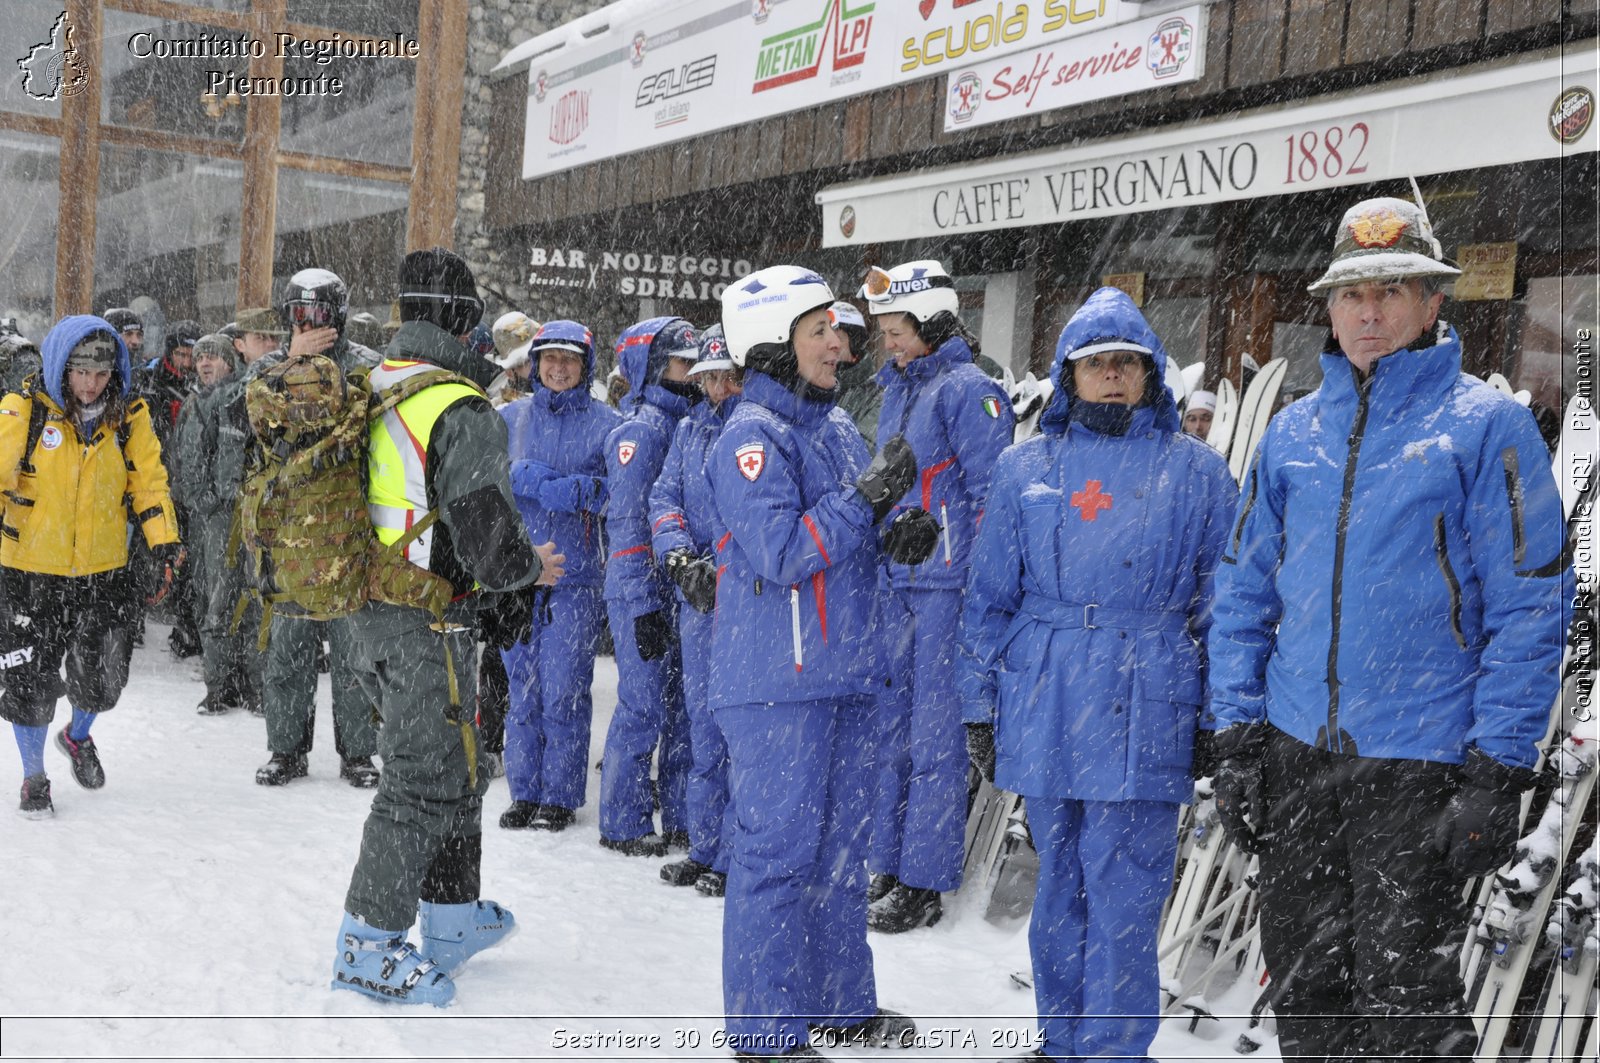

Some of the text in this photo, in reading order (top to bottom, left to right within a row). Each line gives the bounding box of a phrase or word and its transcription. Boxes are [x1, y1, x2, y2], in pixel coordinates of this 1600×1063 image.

[635, 54, 717, 108] SALICE
[984, 42, 1143, 108] Self service
[932, 122, 1370, 230] CAFFE' VERGNANO 1882
[530, 247, 586, 269] BAR
[602, 252, 752, 278] NOLEGGIO
[890, 278, 933, 295] uvex
[337, 971, 409, 1000] LANGE
